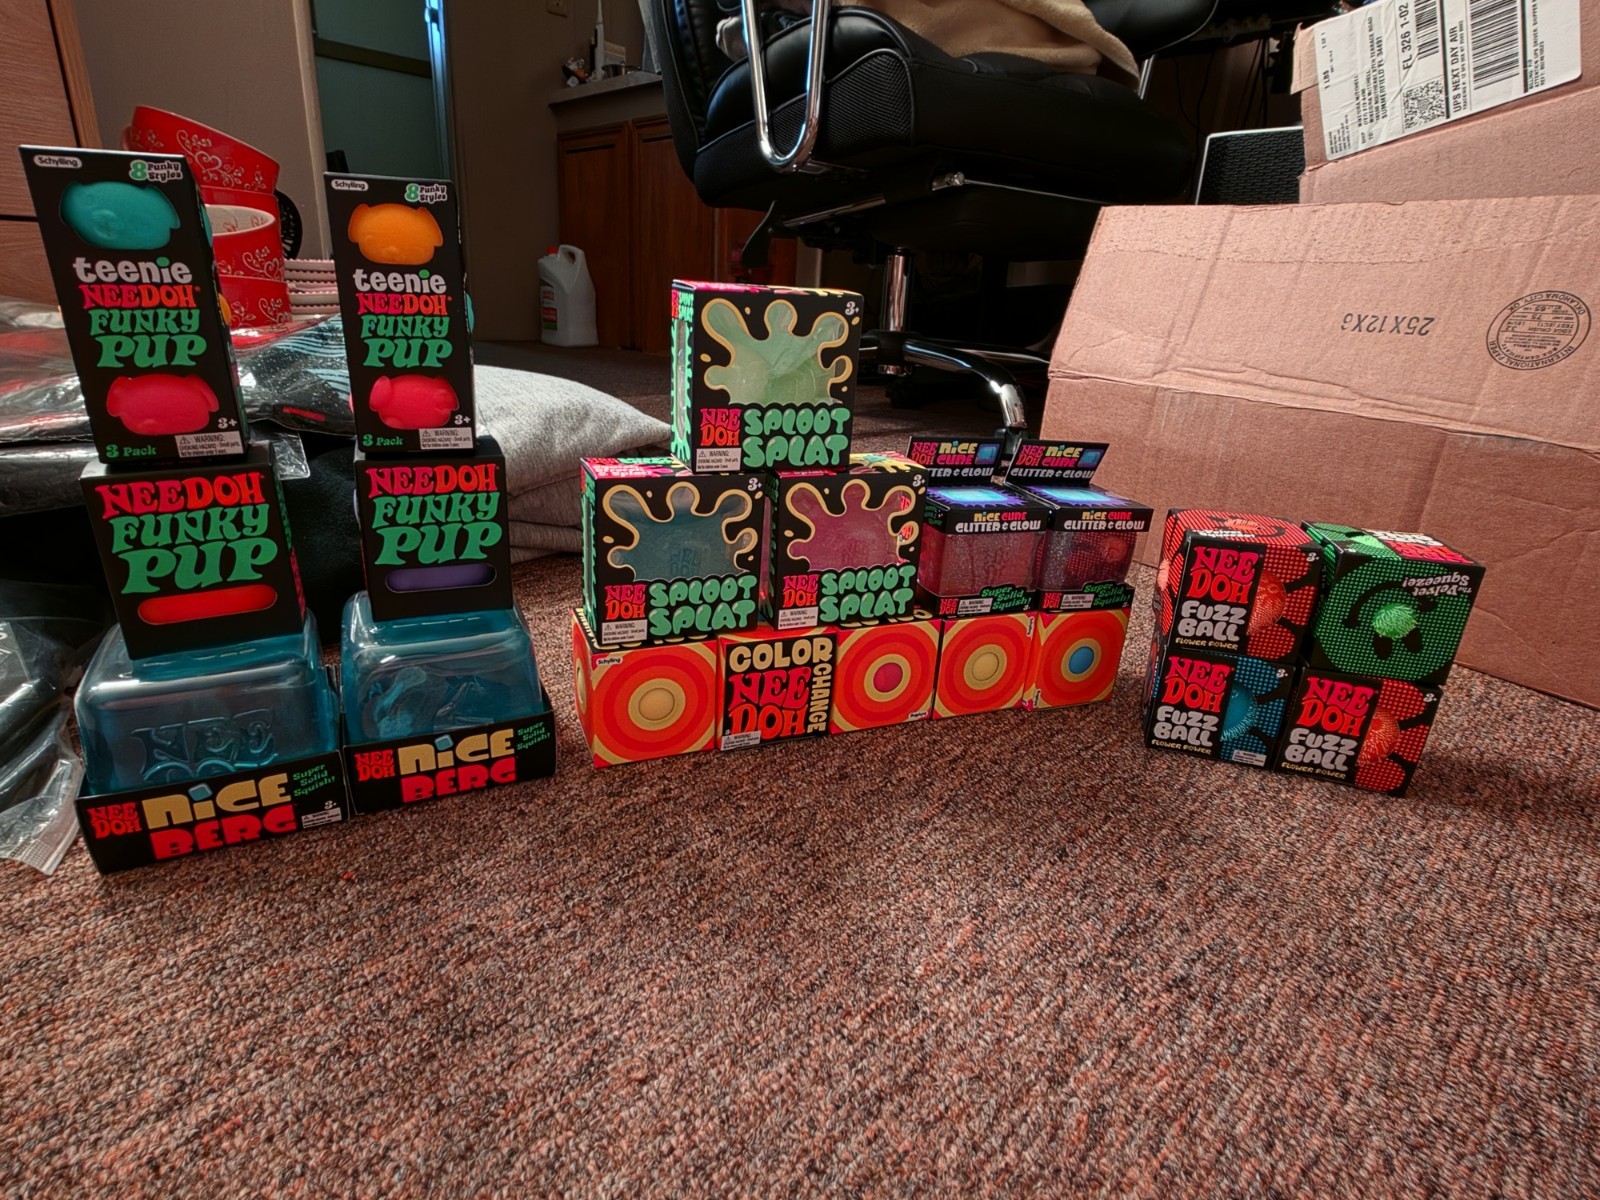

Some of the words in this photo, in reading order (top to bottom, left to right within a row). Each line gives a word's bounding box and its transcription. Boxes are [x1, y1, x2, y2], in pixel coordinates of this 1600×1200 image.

[1398, 2, 1410, 28] 1-02
[1400, 30, 1412, 53] 326
[1449, 26, 1458, 42] AIR
[1402, 54, 1413, 70] FL
[1450, 46, 1459, 65] DAY
[1452, 70, 1461, 92] NEXT
[1378, 68, 1388, 119] SUMMERFIELD
[1452, 94, 1462, 112] UPS
[38, 156, 79, 168] Schylling
[130, 161, 147, 180] 8
[147, 161, 181, 172] Funky
[148, 170, 182, 182] Styles
[334, 180, 366, 190] Schylling
[406, 184, 420, 202] 8
[420, 185, 447, 194] Funky
[420, 192, 447, 204] Styles
[72, 257, 193, 284] teenie
[352, 268, 447, 294] teenie
[78, 284, 197, 310] NEEDOH
[356, 293, 448, 316] NEEDOH
[1508, 302, 1521, 312] OK
[1546, 293, 1586, 315] OKLAHOMA
[844, 301, 860, 316] 3+
[88, 308, 201, 336] FUNKY
[360, 314, 450, 338] FUNKY
[94, 334, 208, 368] PUP
[363, 338, 453, 368] PUP
[1488, 340, 1506, 360] PAPER
[1504, 344, 1575, 368] INTERNATIONAL
[218, 418, 238, 429] 3+
[454, 414, 471, 426] 3+
[700, 408, 742, 431] NEE
[742, 407, 851, 436] SPLOOT
[362, 434, 374, 446] 3
[376, 436, 404, 446] Pack
[700, 424, 740, 446] DOH
[742, 434, 849, 468] SPLAT
[912, 442, 938, 456] NEE
[106, 444, 120, 458] 3
[122, 444, 157, 457] Pack
[911, 452, 935, 465] DOH
[1016, 454, 1041, 466] DOH
[1020, 445, 1046, 458] NEE
[366, 464, 498, 499] NEEDOH
[912, 474, 926, 487] 3+
[961, 468, 994, 477] GLOW
[1010, 468, 1056, 478] GLITTER
[1062, 470, 1095, 478] GLOW
[748, 478, 762, 492] 3+
[95, 472, 266, 519] NEEDOH
[372, 492, 500, 530] FUNKY
[109, 504, 270, 554] FUNKY
[955, 522, 1000, 533] GLITTER
[1010, 520, 1042, 531] GLOW
[1064, 520, 1107, 530] GLITTER
[1114, 520, 1145, 530] GLOW
[374, 522, 502, 565] PUP
[118, 537, 278, 594] PUP
[1190, 546, 1260, 584] NEE
[783, 574, 820, 593] NEE
[820, 565, 916, 596] SPLOOT
[1084, 583, 1114, 593] Super
[1186, 568, 1254, 604] DOH
[1402, 571, 1471, 588] Squeeze!
[604, 584, 647, 605] NEE
[648, 575, 758, 608] SPLOOT
[981, 586, 1012, 598] Super
[997, 590, 1024, 601] Solid
[1043, 592, 1062, 602] NEE
[1098, 586, 1124, 598] Solid
[1412, 584, 1458, 596] Velvet
[1458, 586, 1472, 594] The
[782, 589, 818, 608] DOH
[819, 588, 914, 622] SPLAT
[939, 606, 957, 615] DOH
[940, 598, 959, 608] NEE
[992, 597, 1032, 612] Squish!
[1093, 594, 1131, 607] Squish!
[606, 601, 646, 620] DOH
[648, 600, 756, 636] SPLAT
[1181, 600, 1248, 625] FUZZ
[1178, 618, 1240, 642] BALL
[1175, 637, 1207, 647] FLOWER
[1208, 639, 1238, 650] POWER
[729, 637, 834, 672] COLOR
[1165, 656, 1231, 694] NEE
[728, 666, 812, 711] NEE
[807, 662, 832, 733] CHANGE
[1162, 676, 1225, 713] DOH
[1302, 676, 1374, 717] NEE
[729, 703, 808, 740] DOH
[1156, 705, 1220, 732] FUZZ
[1296, 698, 1366, 737] DOH
[517, 722, 544, 736] Super
[1153, 721, 1214, 747] BALL
[1152, 739, 1182, 749] FLOWER
[1182, 744, 1212, 755] POWER
[1289, 728, 1358, 756] FUZZ
[355, 750, 394, 766] NEE
[1284, 744, 1349, 772] BALL
[292, 764, 326, 780] Super
[300, 770, 328, 786] Solid
[358, 764, 396, 782] DOH
[401, 756, 516, 804] BERG
[1281, 761, 1314, 773] FLOWER
[1315, 768, 1346, 780] POWER
[293, 776, 336, 796] Squish!
[86, 802, 138, 822] NEE
[92, 818, 142, 840] DOH
[150, 804, 297, 860] BERG
